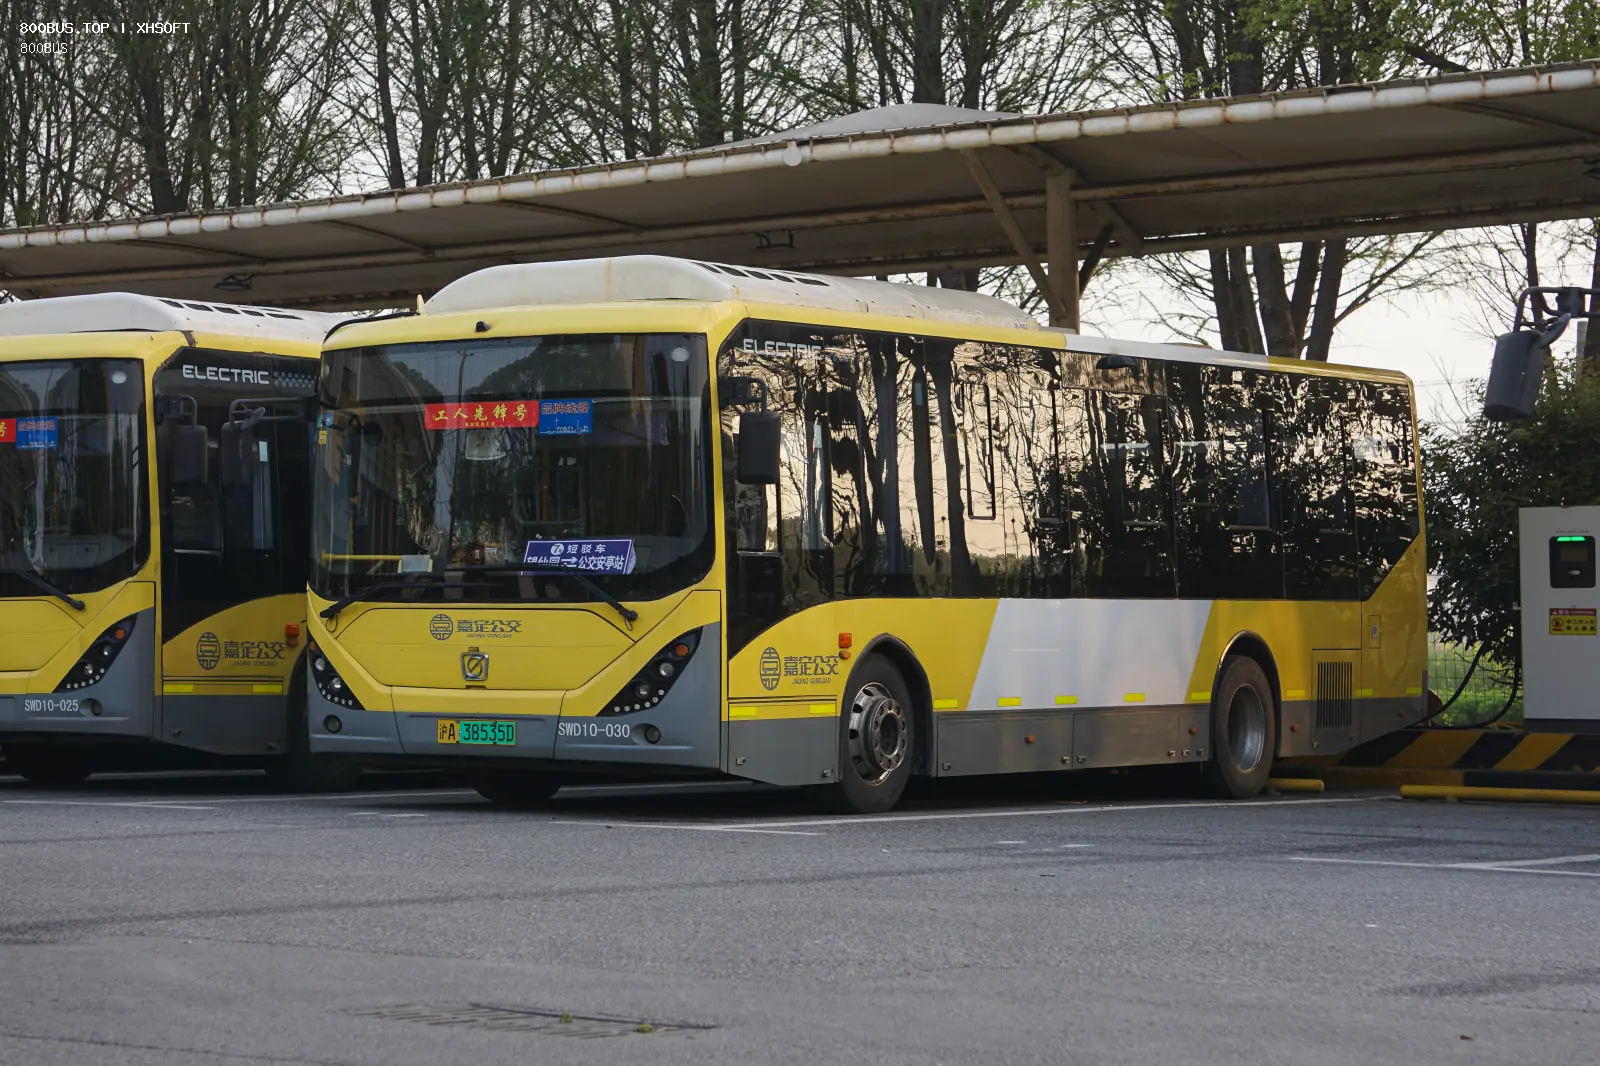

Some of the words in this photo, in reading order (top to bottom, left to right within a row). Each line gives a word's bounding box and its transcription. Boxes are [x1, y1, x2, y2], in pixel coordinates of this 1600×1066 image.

[743, 338, 822, 360] ELECTRIC
[182, 364, 270, 385] ELECTRIC
[434, 403, 528, 421] 工人先锋号
[541, 401, 589, 414] 品牌线路
[566, 543, 607, 554] 短驳车
[578, 555, 625, 570] 公交安亭站
[456, 619, 522, 633] 嘉定公交
[223, 641, 286, 659] 嘉定公交
[784, 655, 839, 676] 嘉定公交
[24, 699, 79, 712] SWD10-025
[558, 722, 631, 738] SWD10-030
